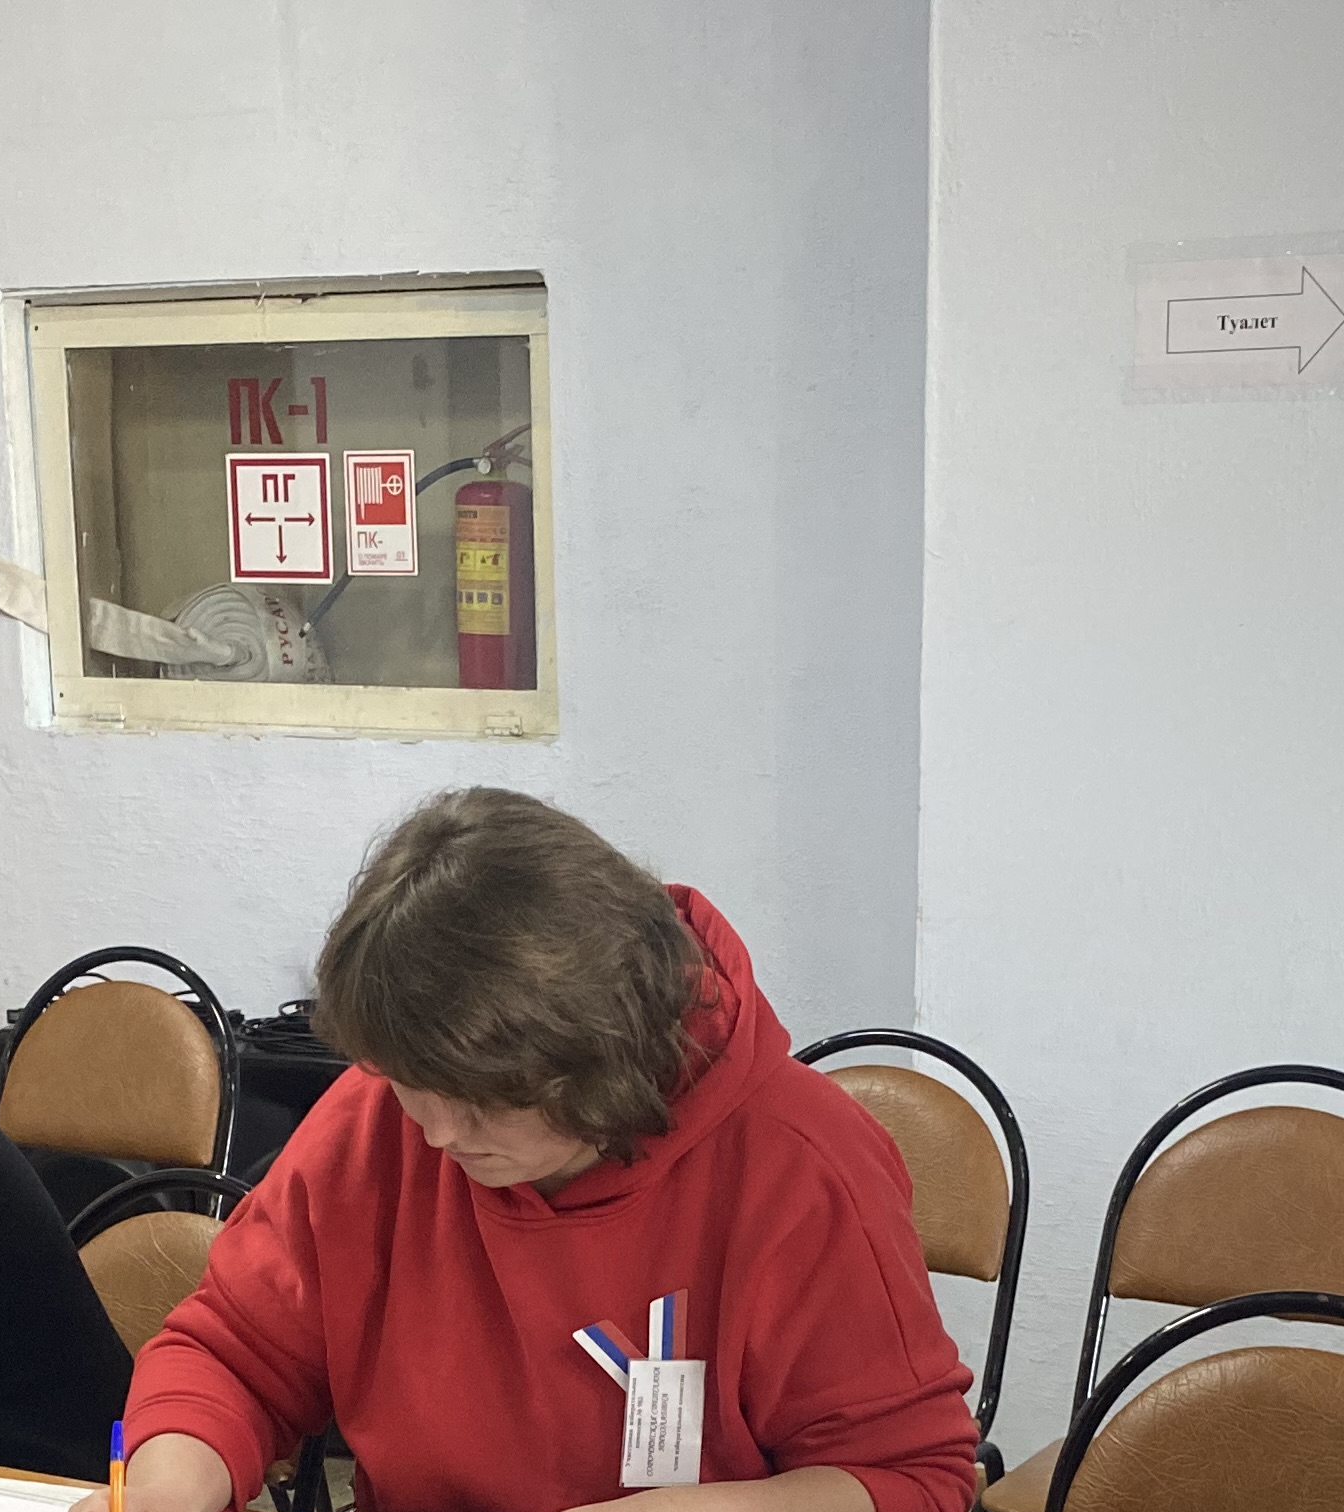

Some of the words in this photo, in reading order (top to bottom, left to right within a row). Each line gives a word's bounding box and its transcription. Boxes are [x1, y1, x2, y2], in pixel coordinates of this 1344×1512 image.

[1216, 312, 1278, 334] Туалет
[227, 376, 328, 446] ПК-1
[261, 473, 296, 503] ПГ
[357, 530, 384, 550] ПК-
